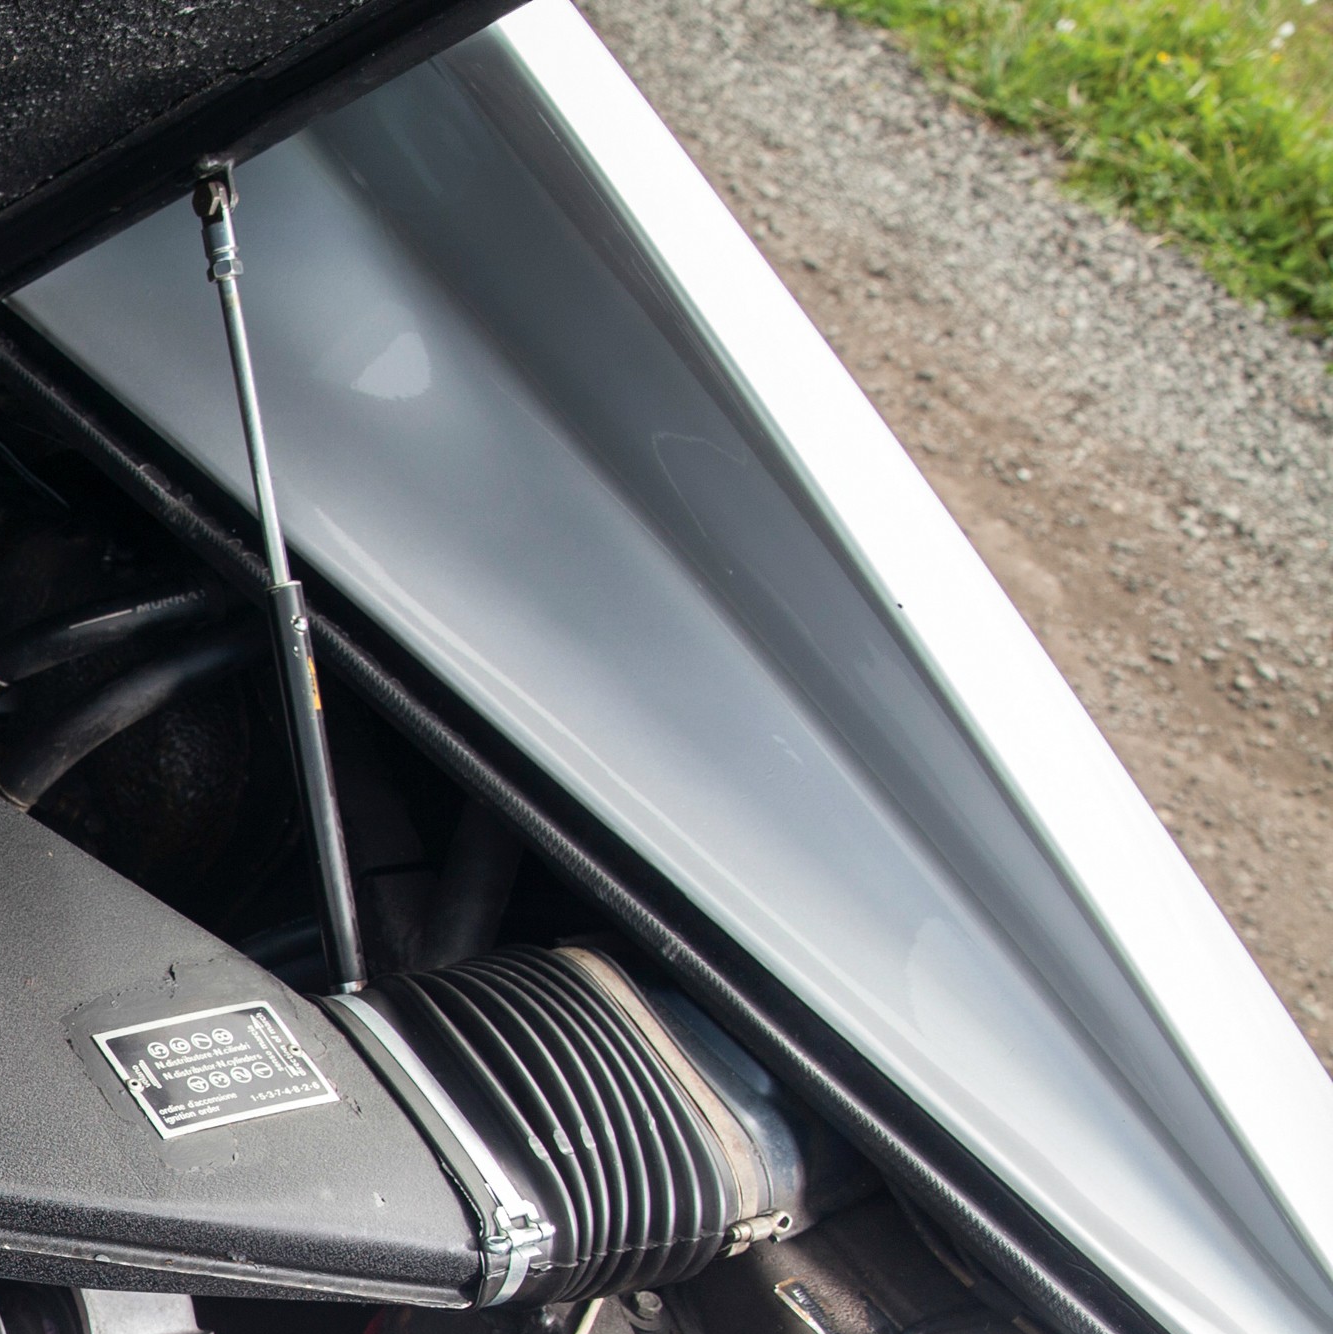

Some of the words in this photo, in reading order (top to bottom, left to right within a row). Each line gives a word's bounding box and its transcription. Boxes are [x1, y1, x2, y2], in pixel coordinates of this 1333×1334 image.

[157, 1103, 187, 1115] ordine
[162, 1109, 199, 1125] ignition
[196, 1104, 222, 1116] order
